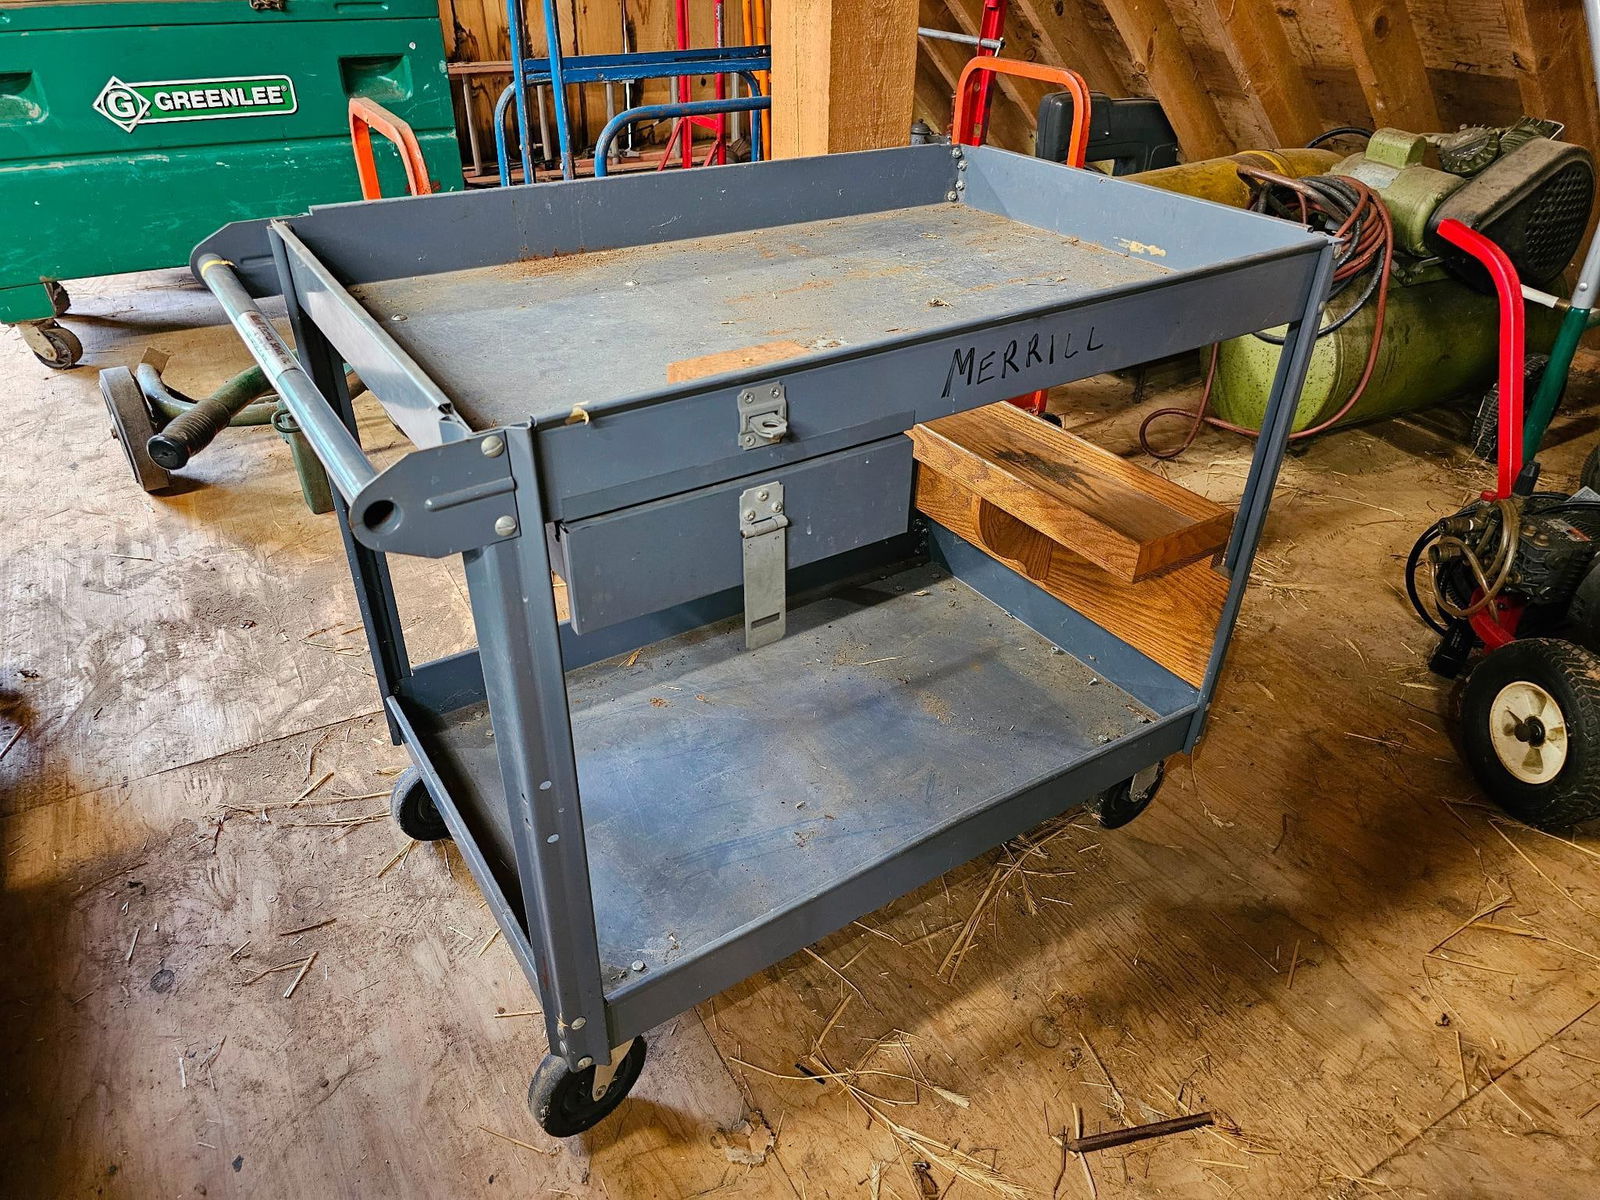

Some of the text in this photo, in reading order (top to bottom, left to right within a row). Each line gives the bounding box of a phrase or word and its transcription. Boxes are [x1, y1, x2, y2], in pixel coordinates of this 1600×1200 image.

[106, 85, 284, 118] G GREENLEE
[941, 326, 1104, 398] MERRILL
